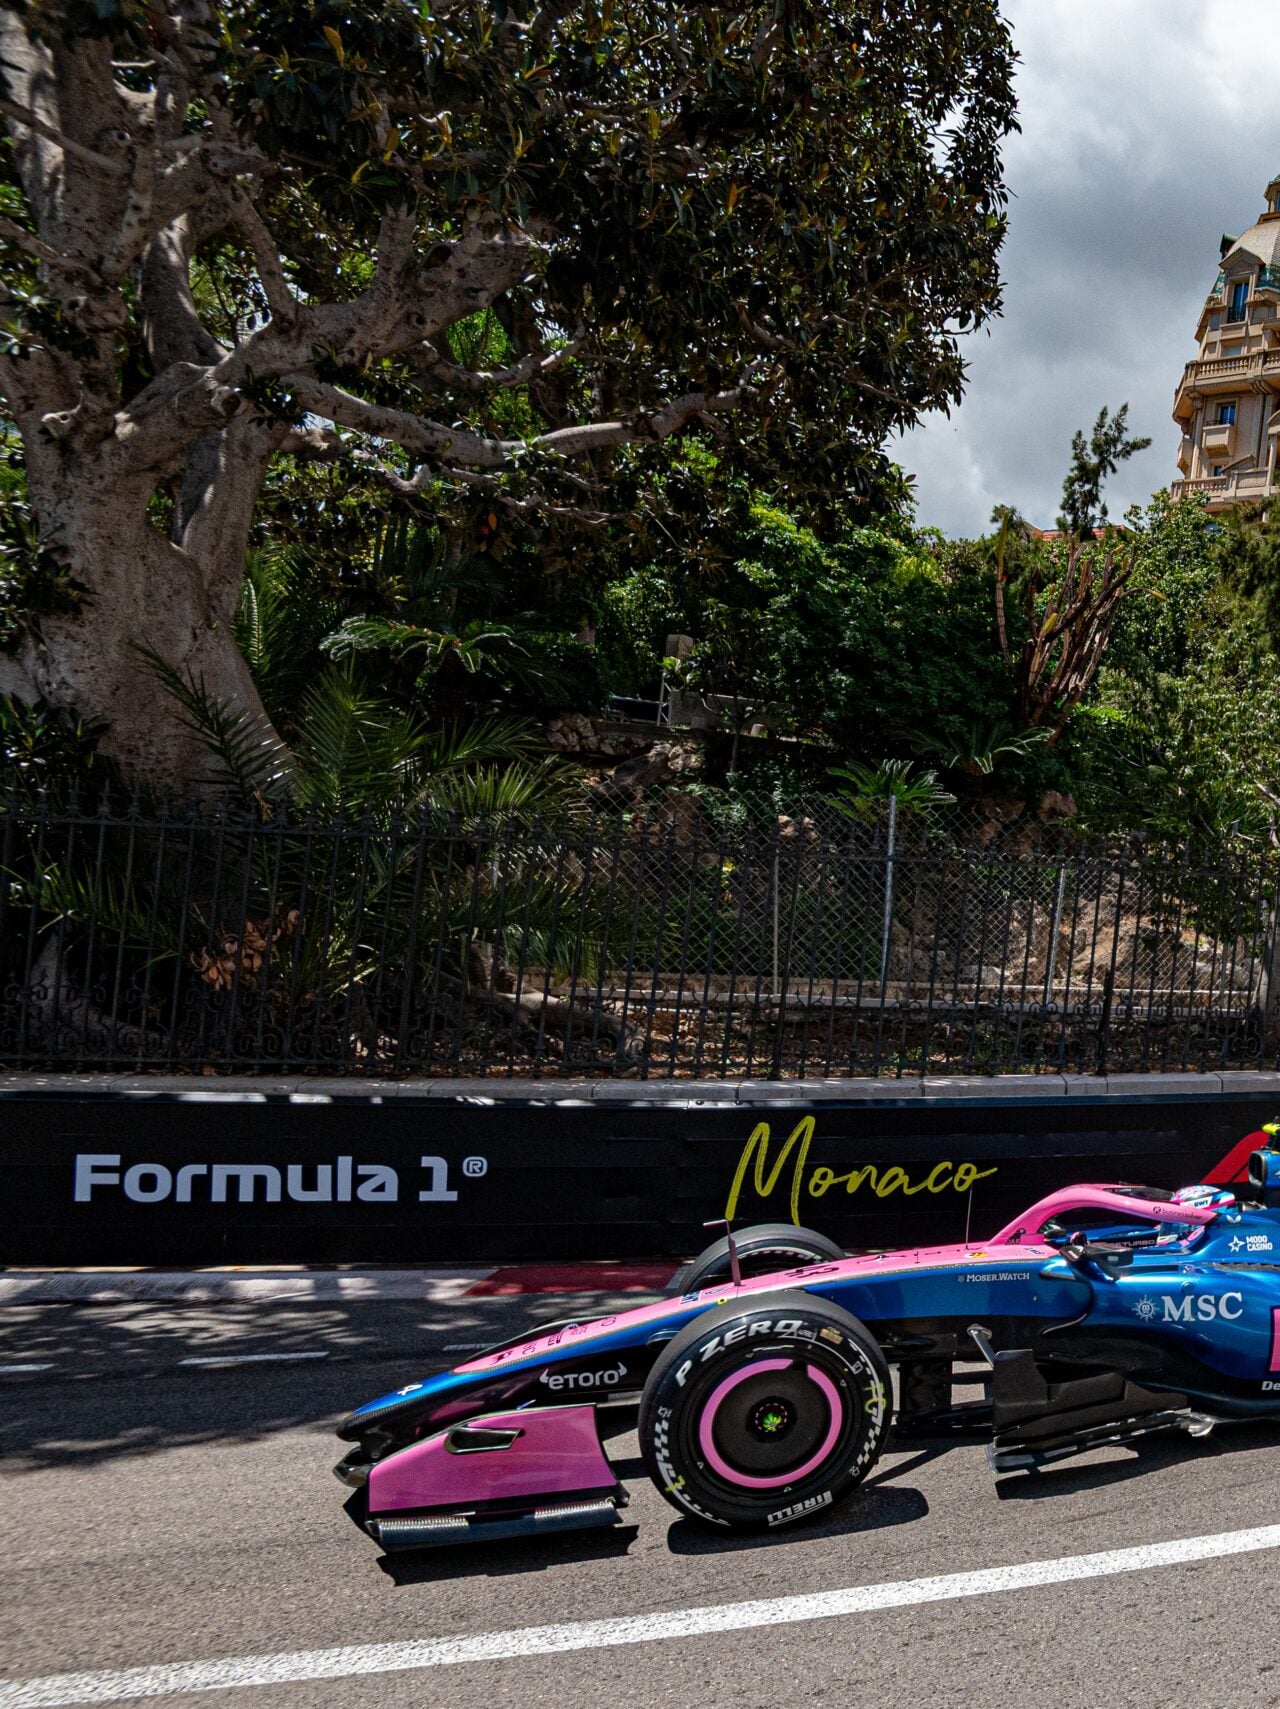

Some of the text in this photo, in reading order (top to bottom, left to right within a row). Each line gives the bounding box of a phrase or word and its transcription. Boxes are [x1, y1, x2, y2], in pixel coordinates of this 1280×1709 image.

[74, 1154, 399, 1203] Formula
[725, 1115, 998, 1226] Monaco
[1246, 1235, 1268, 1244] MODO
[1247, 1243, 1273, 1252] CASINO
[966, 1273, 1030, 1283] MOSER.WATCH
[1161, 1292, 1243, 1322] MSC
[675, 1360, 692, 1387] P
[767, 1490, 833, 1526] PIRELLI
